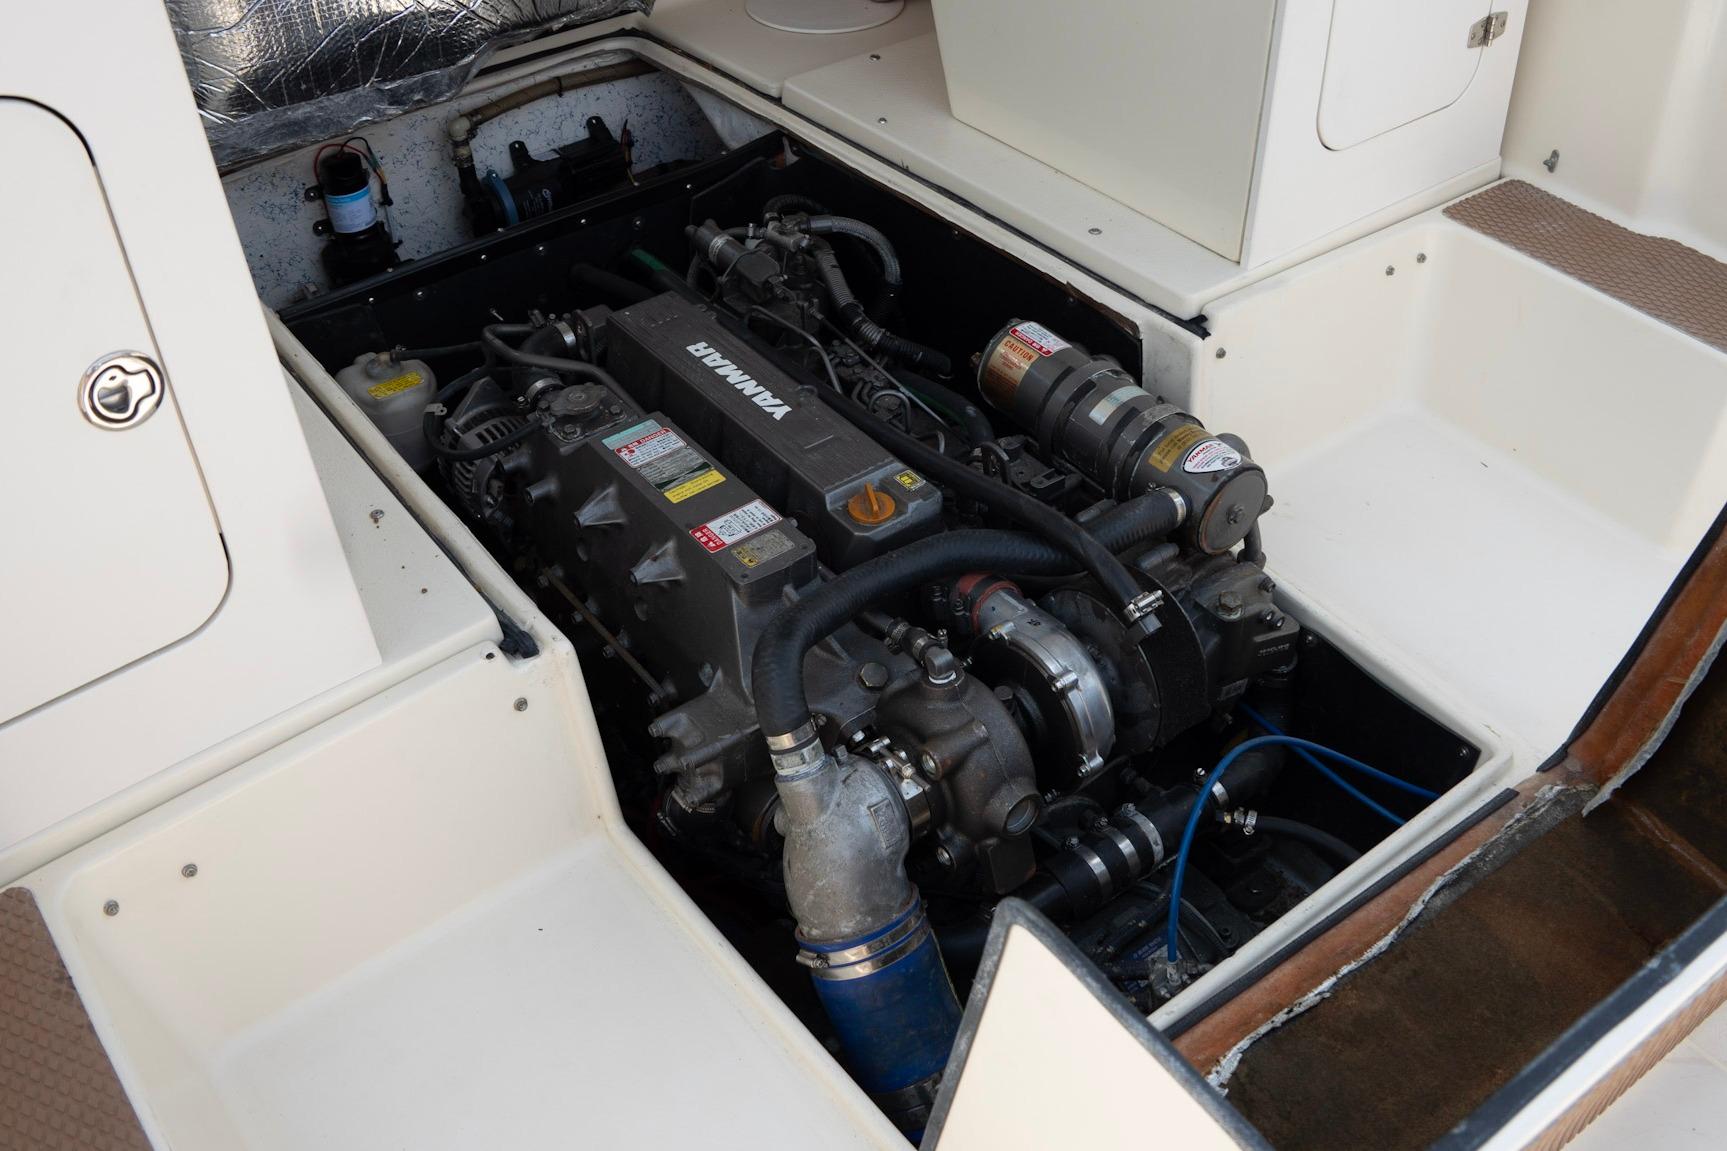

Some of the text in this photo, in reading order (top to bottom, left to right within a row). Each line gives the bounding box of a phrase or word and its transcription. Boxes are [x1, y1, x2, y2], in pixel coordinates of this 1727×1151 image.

[1004, 340, 1034, 362] CAUTION
[686, 341, 792, 421] YANMAR
[640, 429, 667, 444] DANGER
[702, 527, 723, 546] DANGER
